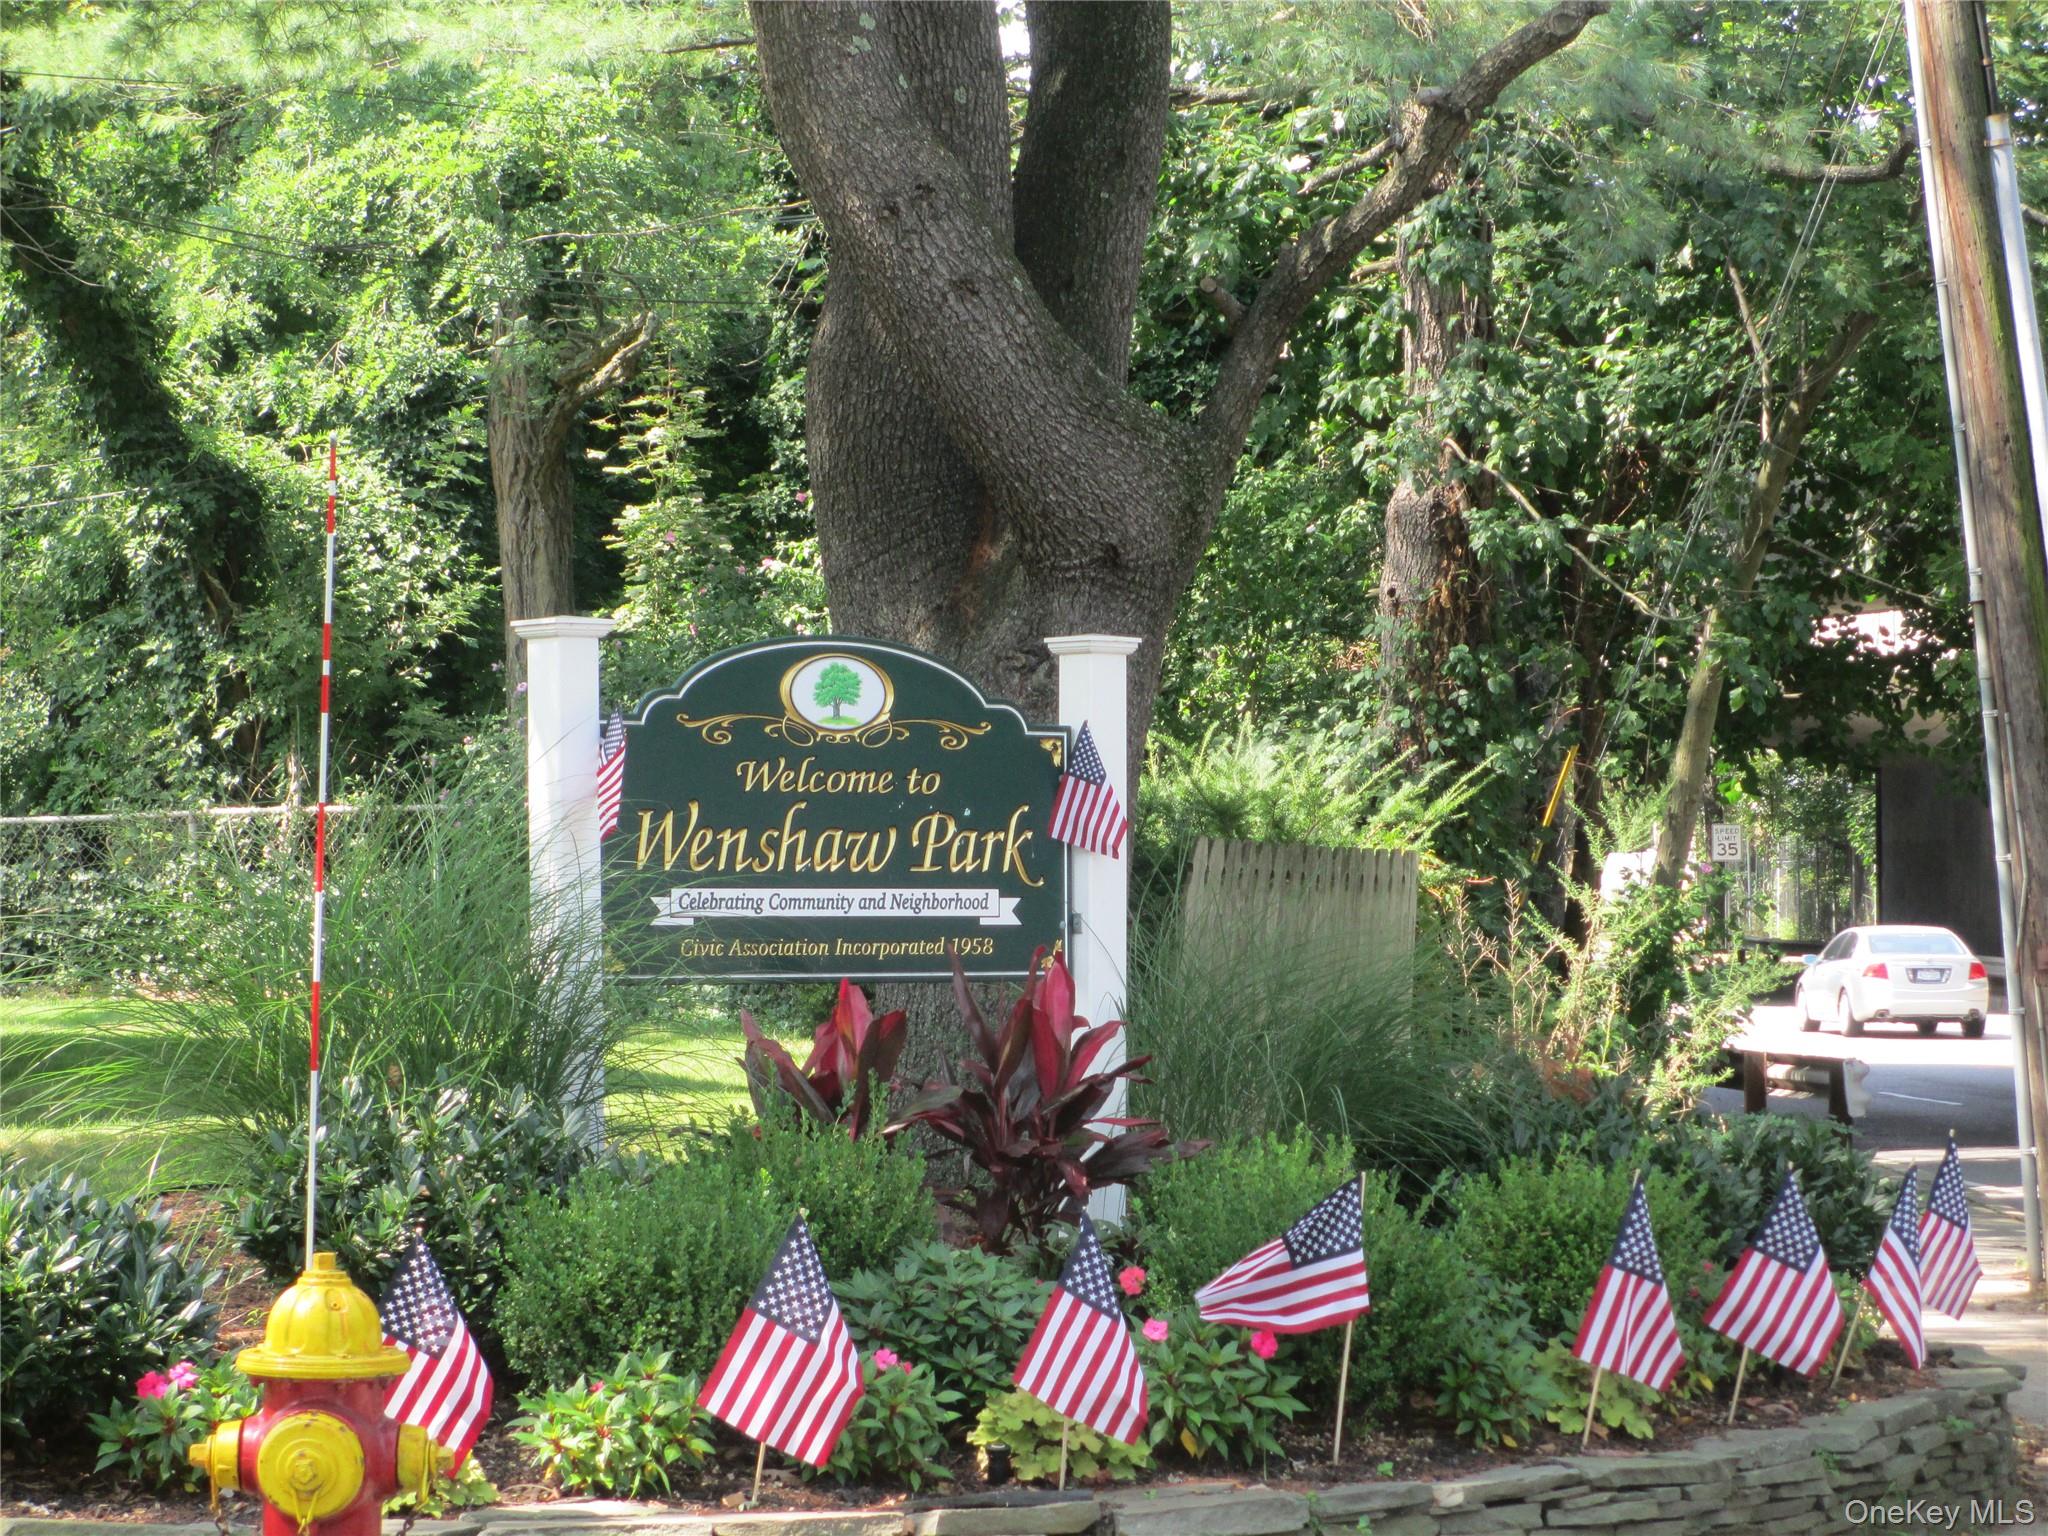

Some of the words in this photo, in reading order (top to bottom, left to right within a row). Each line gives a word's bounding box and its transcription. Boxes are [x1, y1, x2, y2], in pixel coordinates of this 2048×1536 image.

[736, 756, 895, 794] Welcome
[907, 766, 942, 795] to
[635, 801, 897, 874] Wenshaw
[910, 804, 1044, 887] Park
[1717, 843, 1738, 856] 35
[678, 892, 764, 915] Celebrating
[768, 892, 855, 915] Community
[858, 892, 887, 911] and
[889, 892, 990, 914] Neighborhood
[680, 938, 725, 957] Civic
[728, 937, 830, 957] Association
[835, 937, 946, 961] Incorporated
[952, 937, 994, 956] 1958
